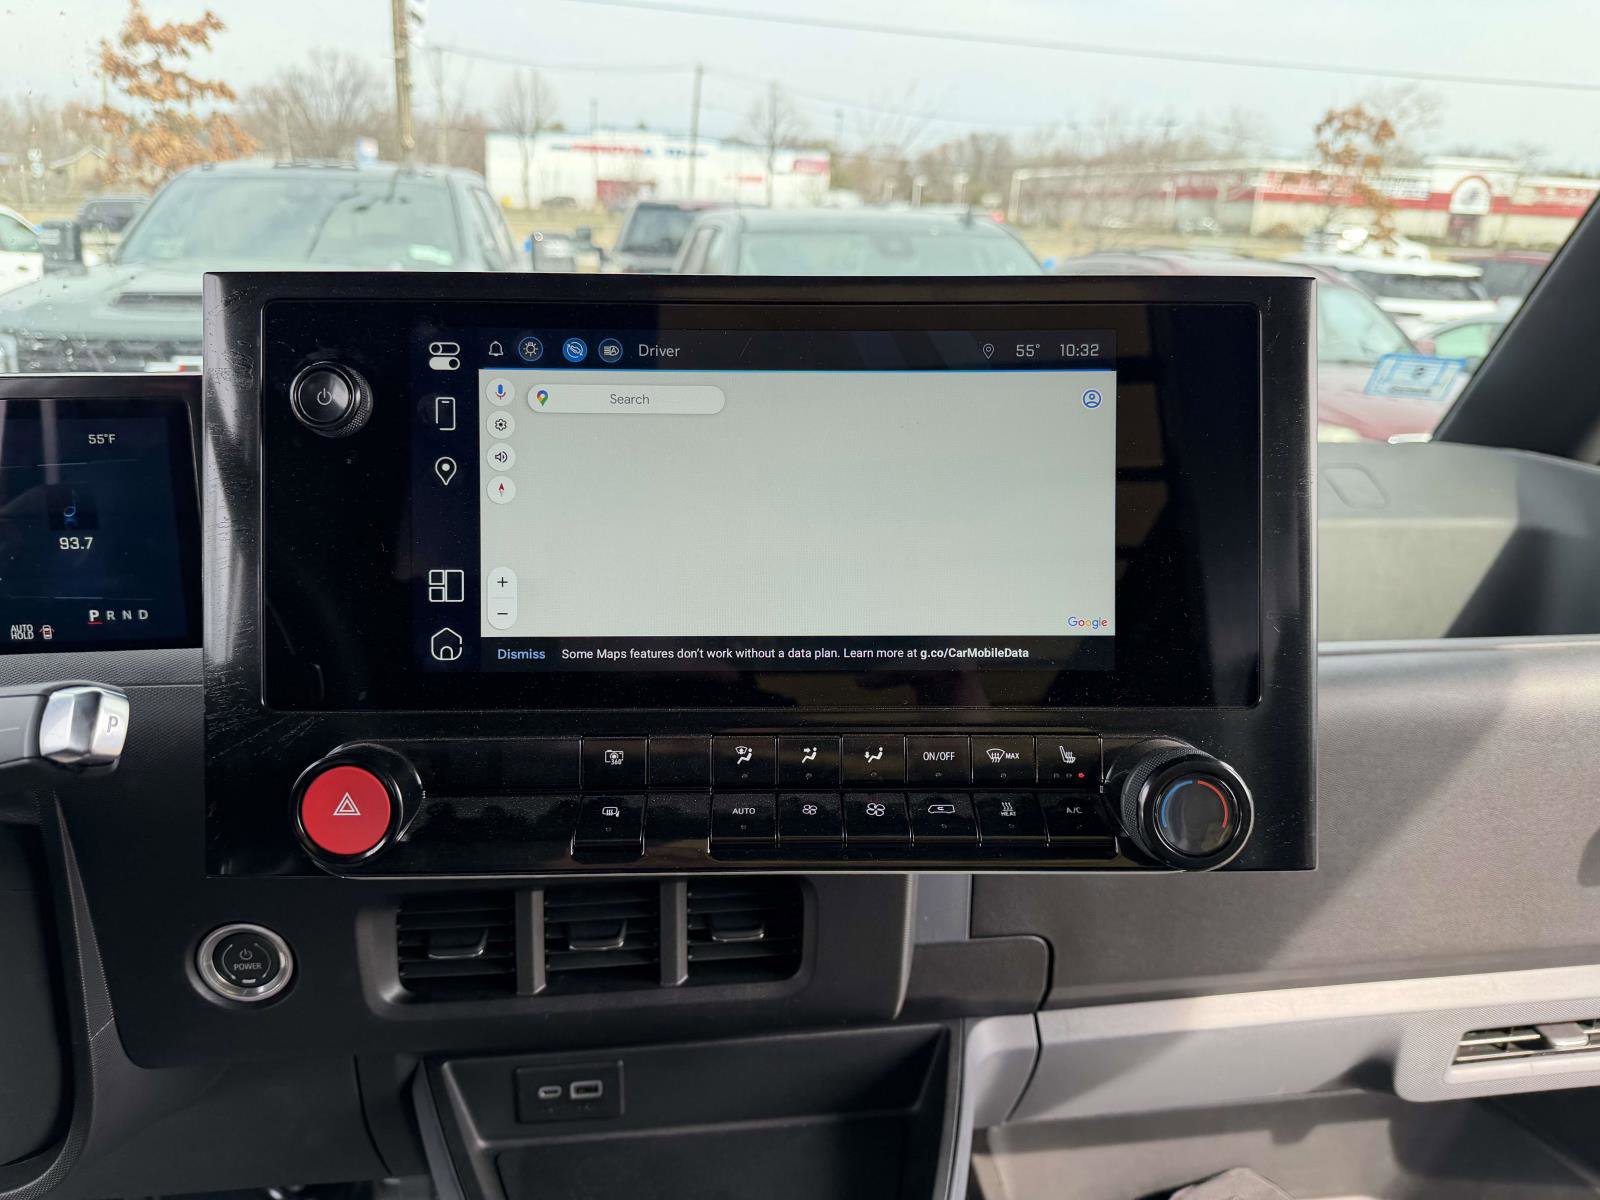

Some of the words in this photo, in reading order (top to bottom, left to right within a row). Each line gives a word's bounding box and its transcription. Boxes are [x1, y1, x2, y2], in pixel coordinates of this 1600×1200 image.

[639, 344, 680, 357] Driver
[1016, 343, 1041, 357] 55°
[1060, 344, 1100, 357] 10:32
[610, 394, 650, 405] Search
[88, 433, 116, 444] 55°F
[59, 537, 93, 550] 93.7
[89, 610, 99, 621] P
[106, 610, 115, 621] R
[122, 610, 132, 620] N
[139, 609, 149, 620] D
[11, 624, 34, 633] AUTO
[1067, 616, 1108, 630] Google
[11, 631, 34, 640] HOLD
[497, 648, 546, 660] Dismiss
[561, 649, 594, 659] Some
[597, 649, 627, 662] Maps
[630, 648, 674, 659] features
[706, 648, 733, 659] work
[735, 648, 776, 659] without
[778, 651, 785, 659] a
[788, 648, 812, 658] data
[814, 648, 841, 661] plan.
[843, 648, 874, 658] Learn
[876, 650, 904, 658] more
[907, 649, 918, 658] at
[920, 648, 1030, 660] g.co/CarMobileData
[923, 751, 956, 761] ON/OFF
[1005, 752, 1020, 760] MAX
[732, 807, 756, 815] AUTO
[1066, 806, 1083, 814] A/C
[233, 962, 262, 971] POWER
